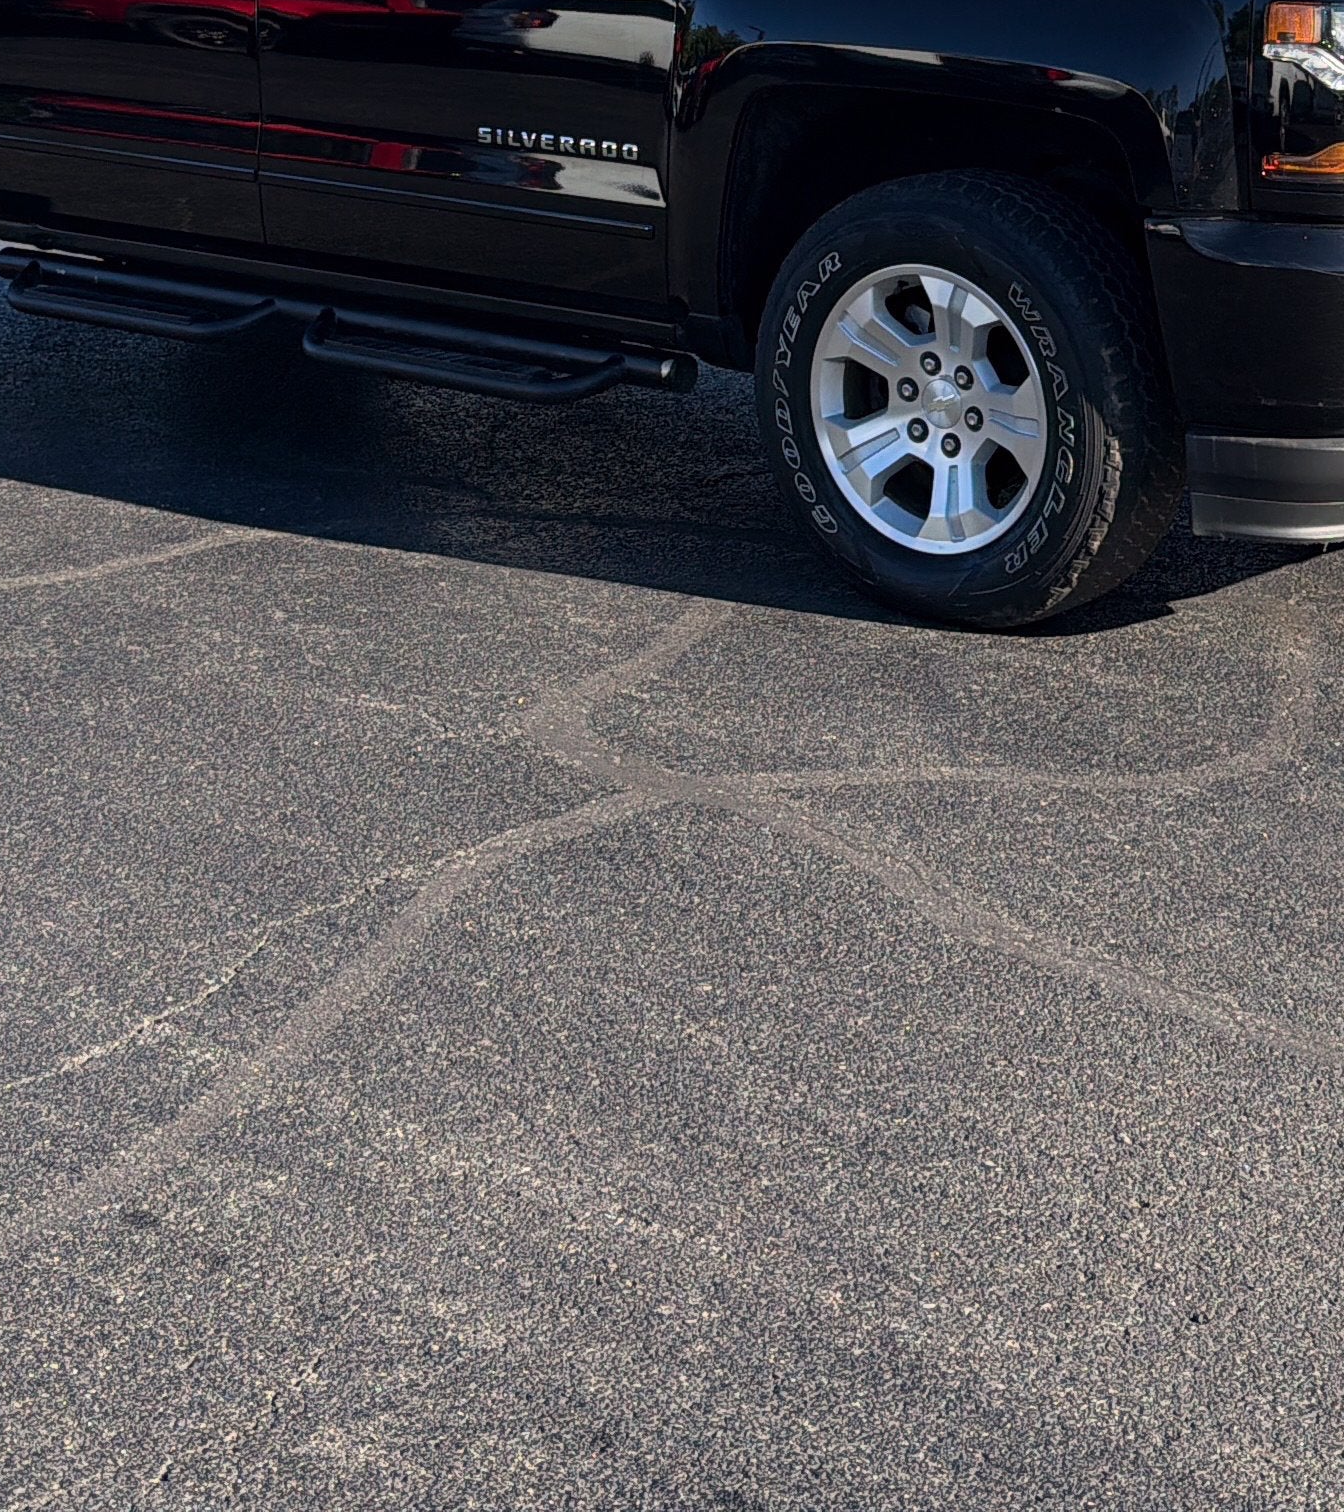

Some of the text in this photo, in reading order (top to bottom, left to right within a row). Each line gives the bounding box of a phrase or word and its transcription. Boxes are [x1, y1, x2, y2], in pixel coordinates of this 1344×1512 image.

[477, 126, 639, 161] SILVERADO
[772, 251, 843, 534] GOODYEAR
[1006, 283, 1076, 574] WRANGLER
